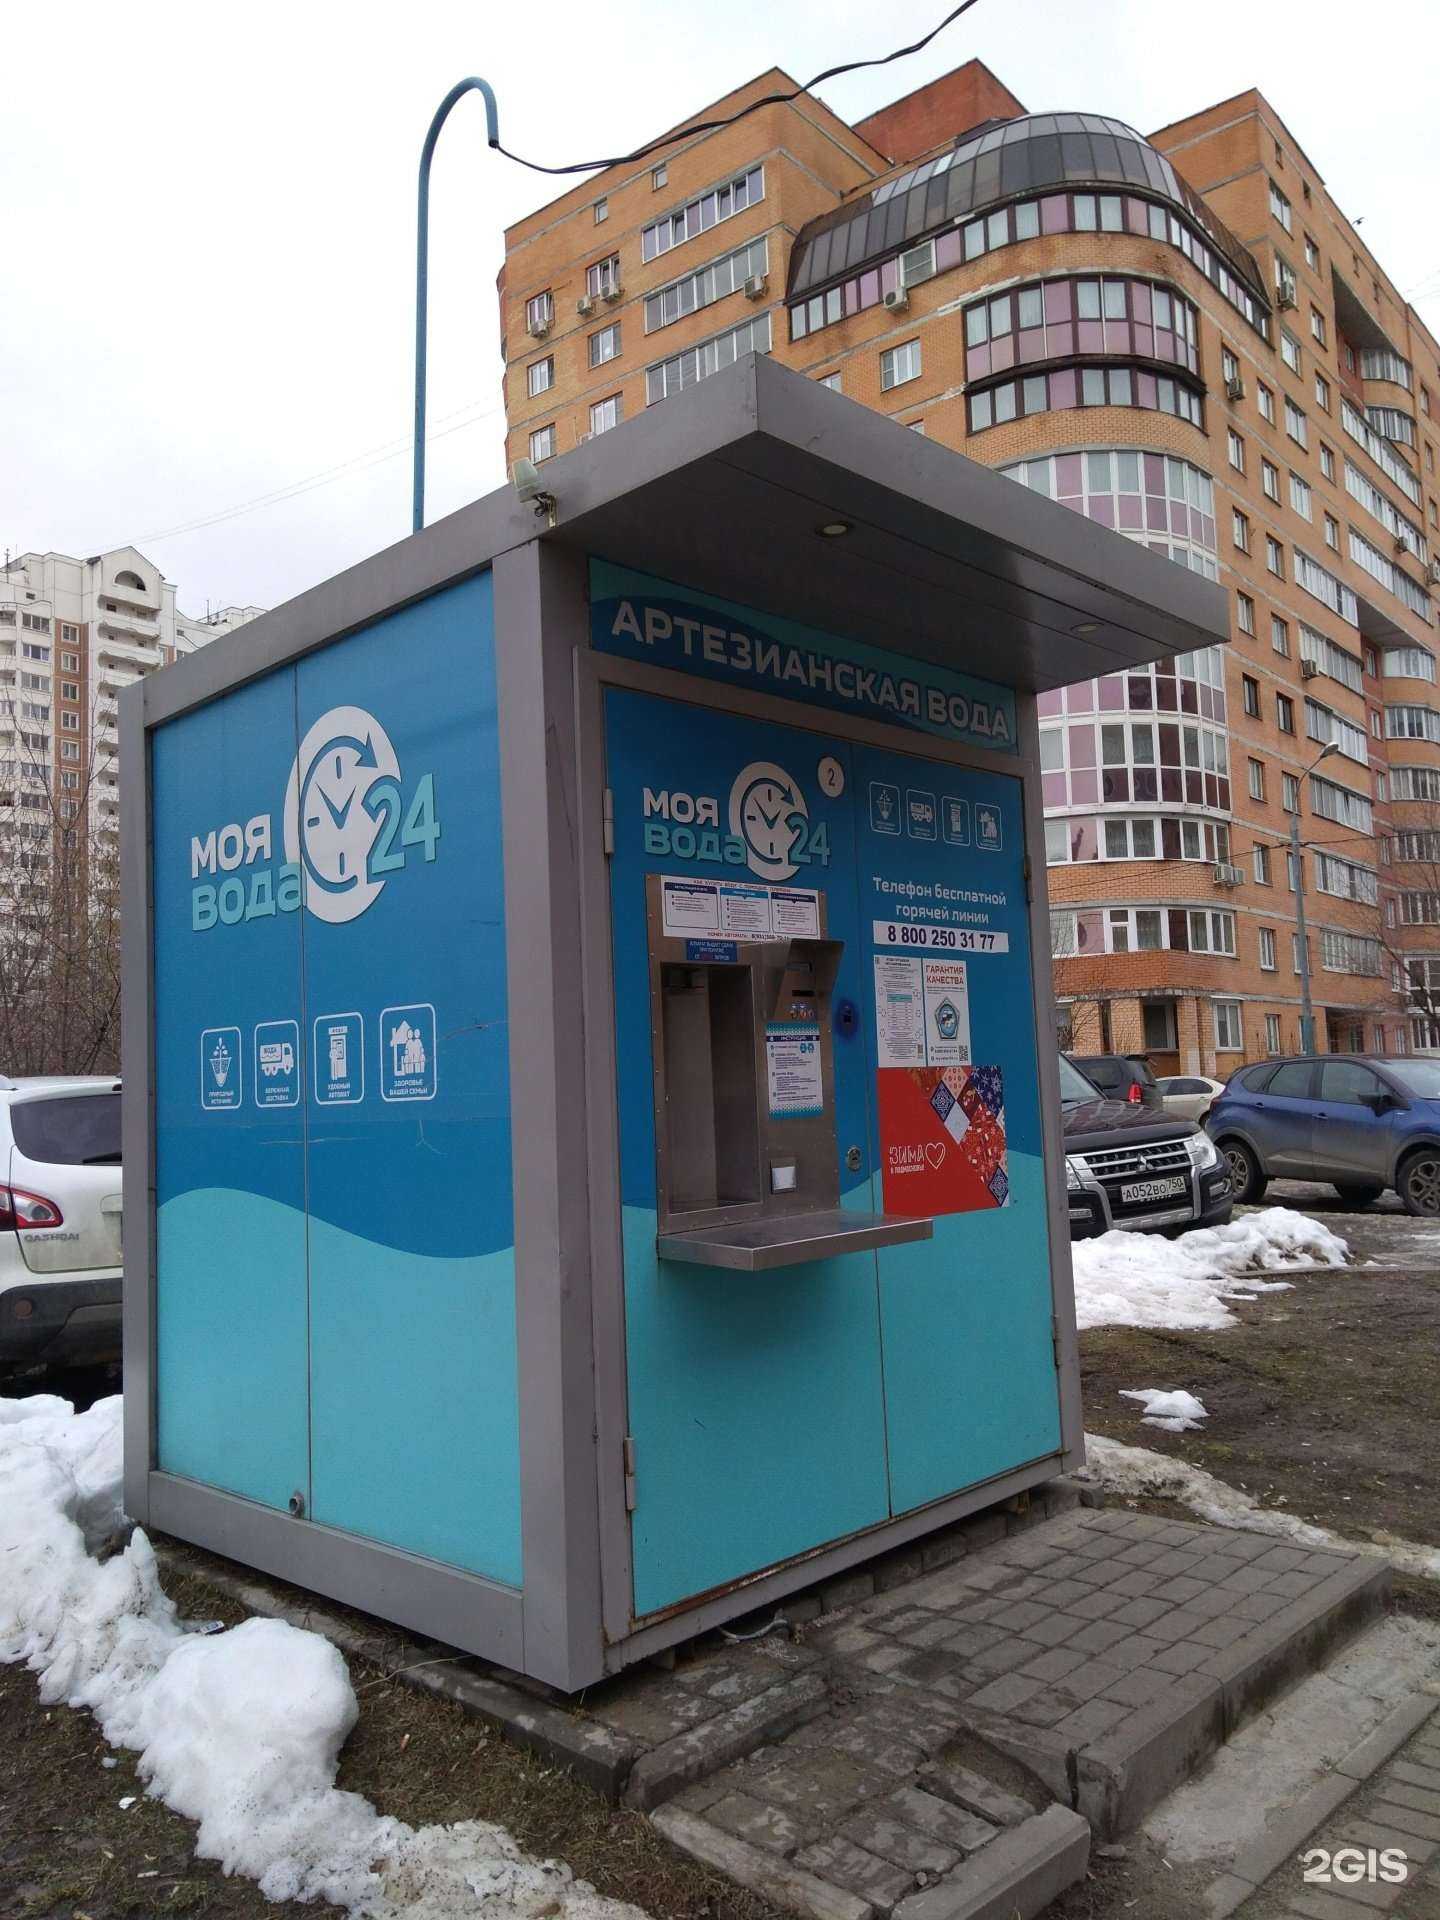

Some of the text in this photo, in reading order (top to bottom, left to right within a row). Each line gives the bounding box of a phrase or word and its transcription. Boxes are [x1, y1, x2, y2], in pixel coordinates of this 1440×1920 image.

[611, 600, 1010, 741] АРТЕЗИАНСКАЯ ВОДА
[827, 767, 837, 787] 2
[642, 787, 720, 828] МОЯ
[368, 773, 441, 875] 24
[191, 814, 272, 879] МОЯ
[787, 816, 832, 867] 24
[872, 877, 1007, 906] Телефон бесплатной
[895, 904, 989, 924] горячей линии
[887, 925, 995, 951] 8 800 250 31 77
[925, 964, 964, 975] ГАРАНТИЯ
[926, 975, 964, 985] КАЧЕСТВА
[24, 1233, 80, 1242] QASHQAI
